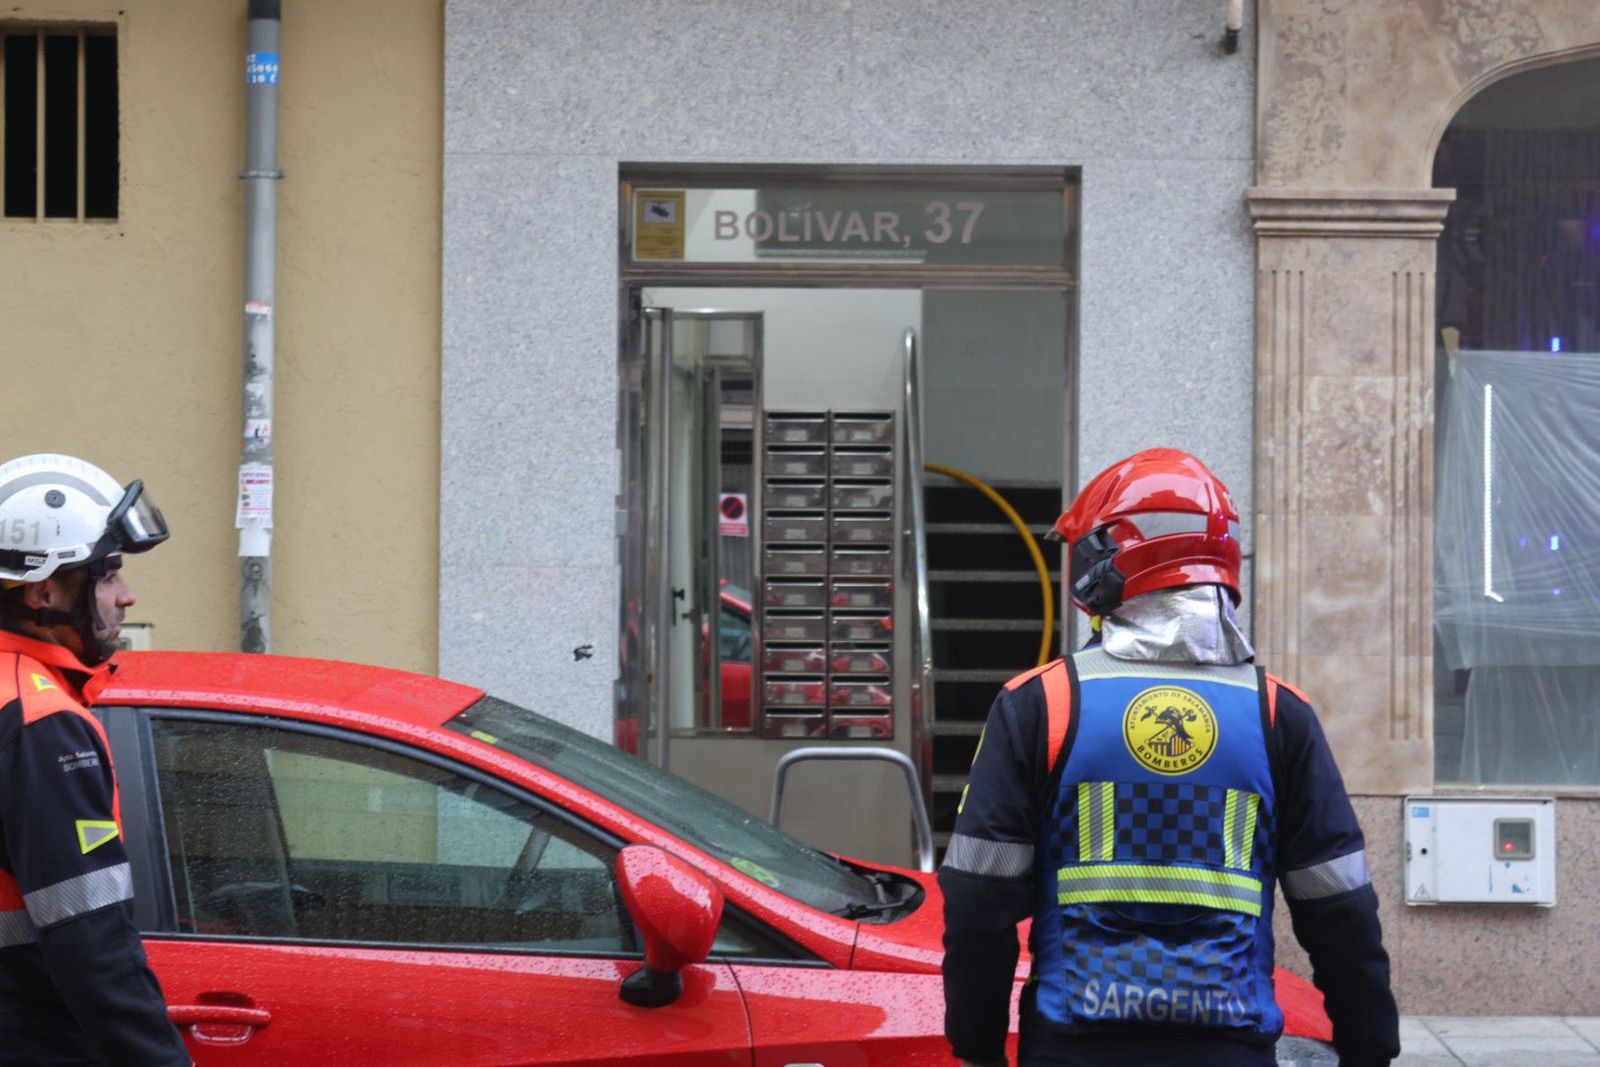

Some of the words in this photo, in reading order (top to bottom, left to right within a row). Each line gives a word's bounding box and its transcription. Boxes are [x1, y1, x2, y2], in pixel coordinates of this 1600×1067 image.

[924, 201, 985, 244] 37
[0, 518, 40, 545] 151
[1137, 745, 1203, 769] BOMBEROS
[1083, 978, 1247, 1024] SARGENTO
